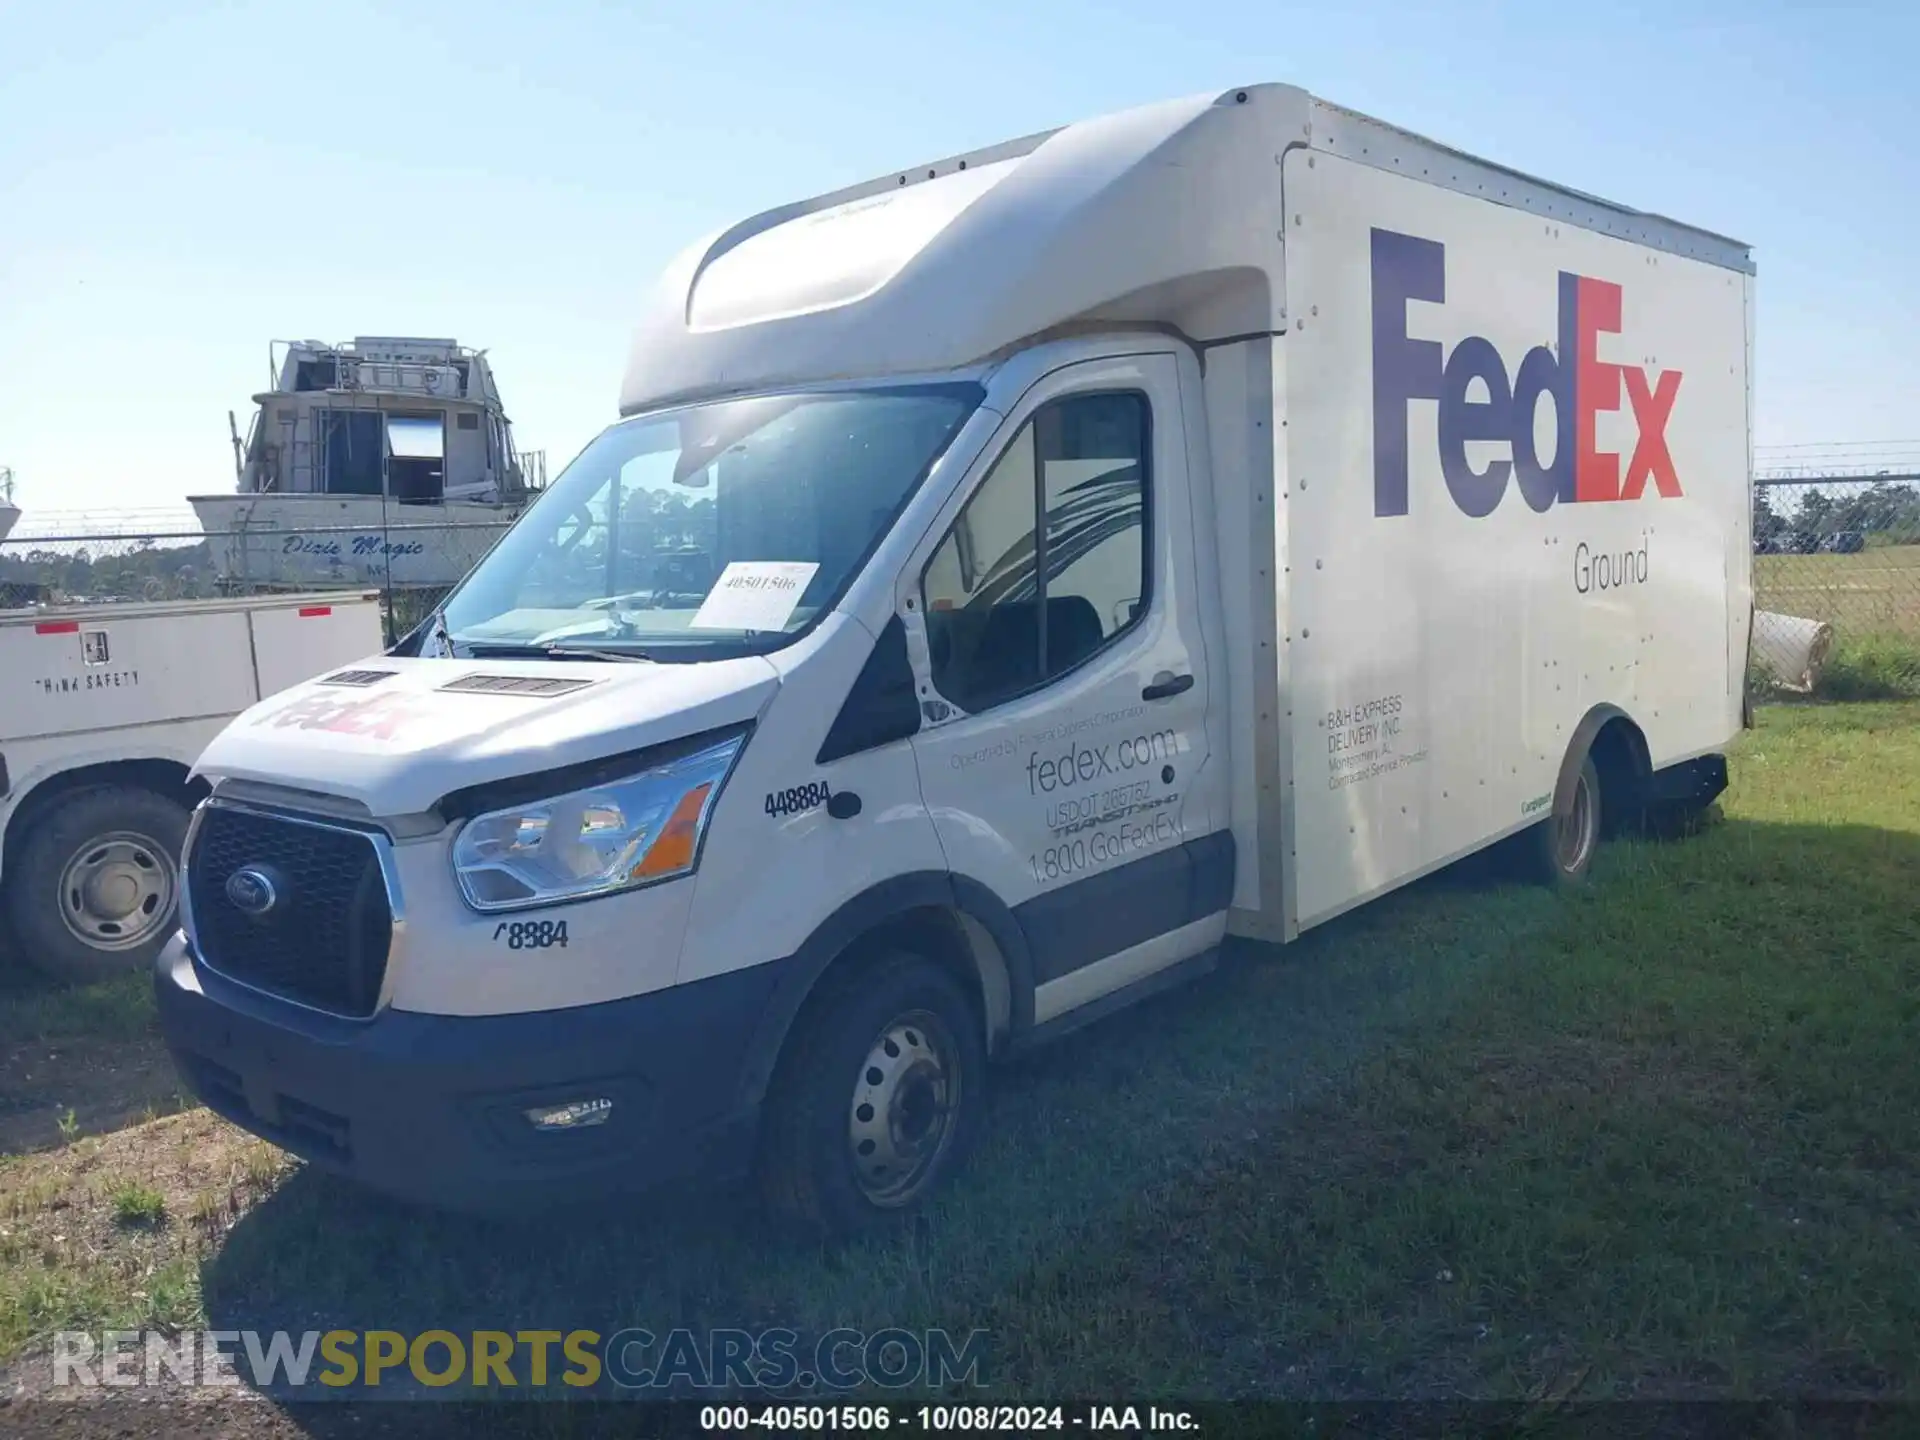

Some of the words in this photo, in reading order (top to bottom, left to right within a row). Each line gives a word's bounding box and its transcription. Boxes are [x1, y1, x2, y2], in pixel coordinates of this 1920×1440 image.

[1371, 227, 1684, 518] FedEx
[351, 535, 424, 562] Magic
[1574, 537, 1648, 593] Ground
[725, 575, 797, 591] 40501506
[1354, 694, 1403, 722] EXPRESS
[1328, 722, 1379, 754] DELIVERY
[1025, 727, 1180, 796] fedex.com
[764, 780, 831, 818] 448884
[1046, 791, 1099, 829] USDOT
